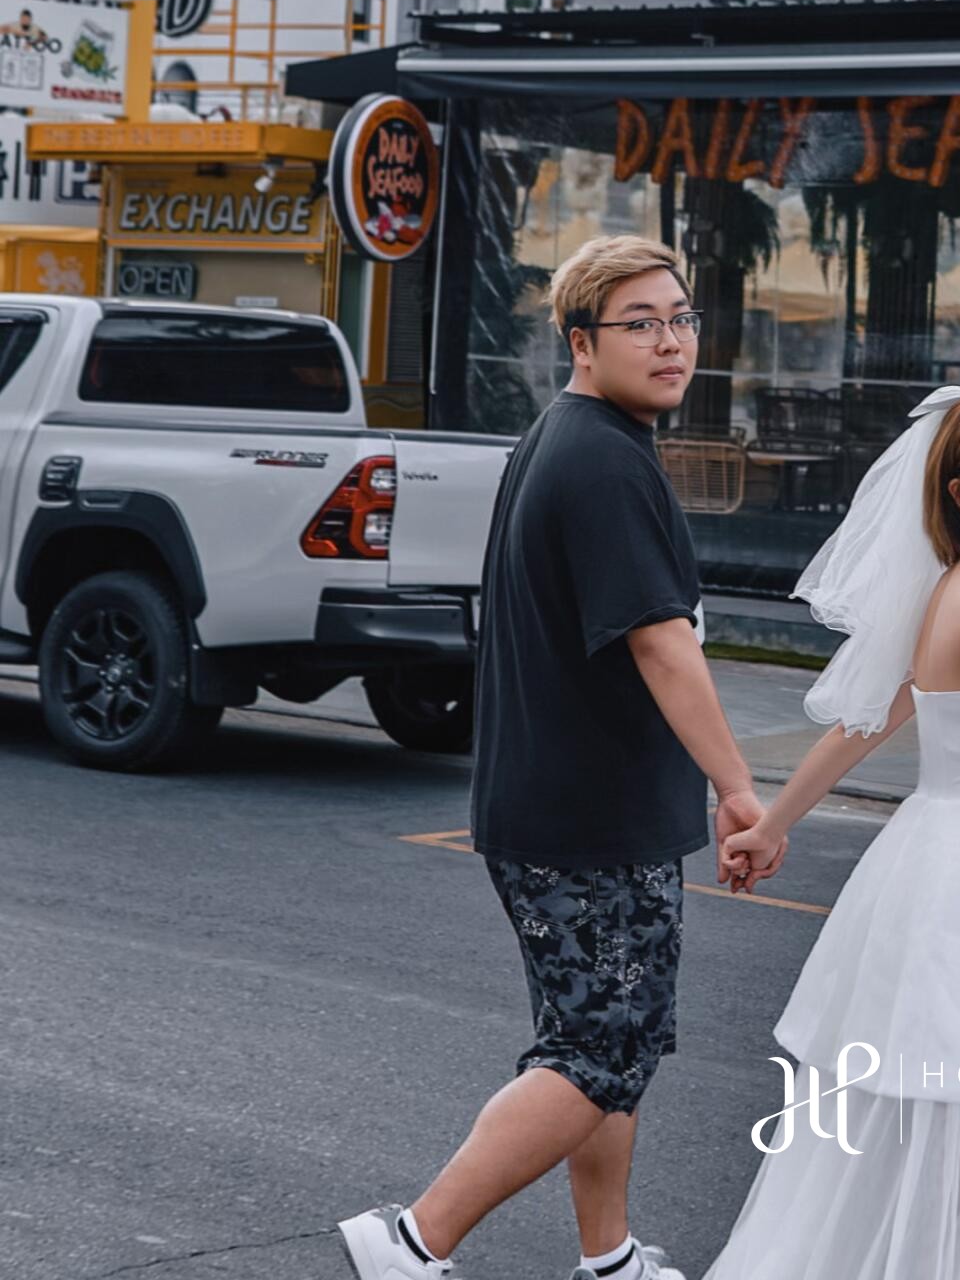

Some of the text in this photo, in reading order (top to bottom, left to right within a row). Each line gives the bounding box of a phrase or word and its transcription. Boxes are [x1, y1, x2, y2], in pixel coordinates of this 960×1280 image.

[43, 127, 73, 146] THE
[379, 126, 420, 168] DAILY
[614, 97, 815, 189] DAILY
[367, 155, 424, 200] SEAFOOD
[119, 193, 312, 234] EXCHANGE
[119, 266, 189, 295] OPEN
